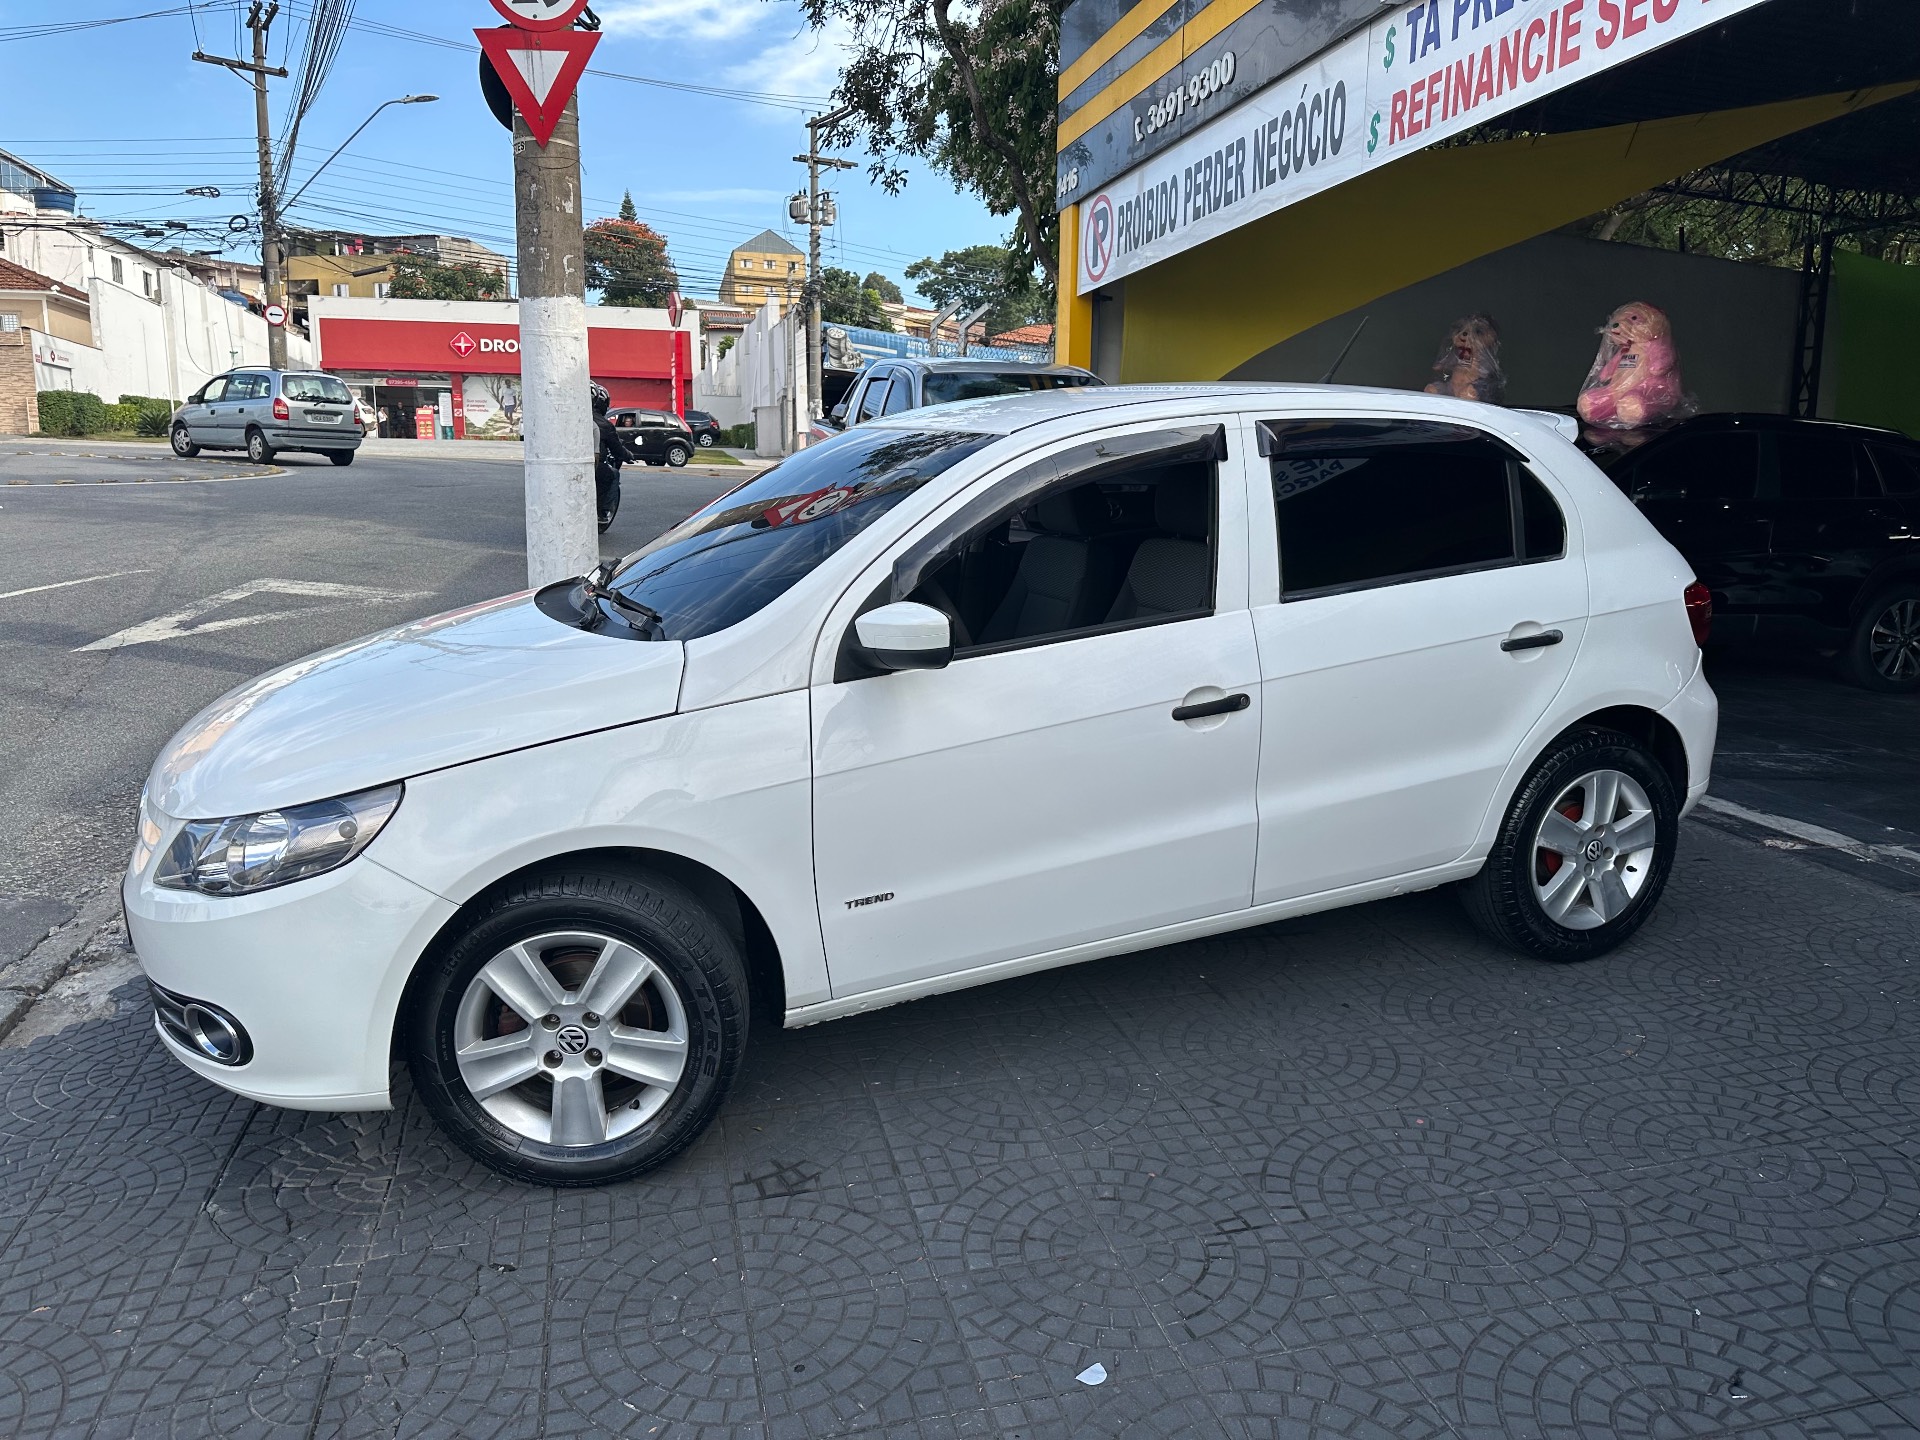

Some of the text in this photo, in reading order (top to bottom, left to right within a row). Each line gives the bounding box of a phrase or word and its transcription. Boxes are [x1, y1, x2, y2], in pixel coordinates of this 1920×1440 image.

[1388, 0, 1584, 145] REFINANCIE
[1147, 51, 1236, 134] 3691-9300
[1057, 167, 1079, 198] 1416
[1116, 174, 1179, 258] PROIBIDO
[1183, 136, 1246, 226] PERDER
[1252, 79, 1347, 194] NEGÓCIO
[480, 338, 521, 353] DRO
[906, 340, 923, 351] AUTO
[844, 891, 895, 910] TREND
